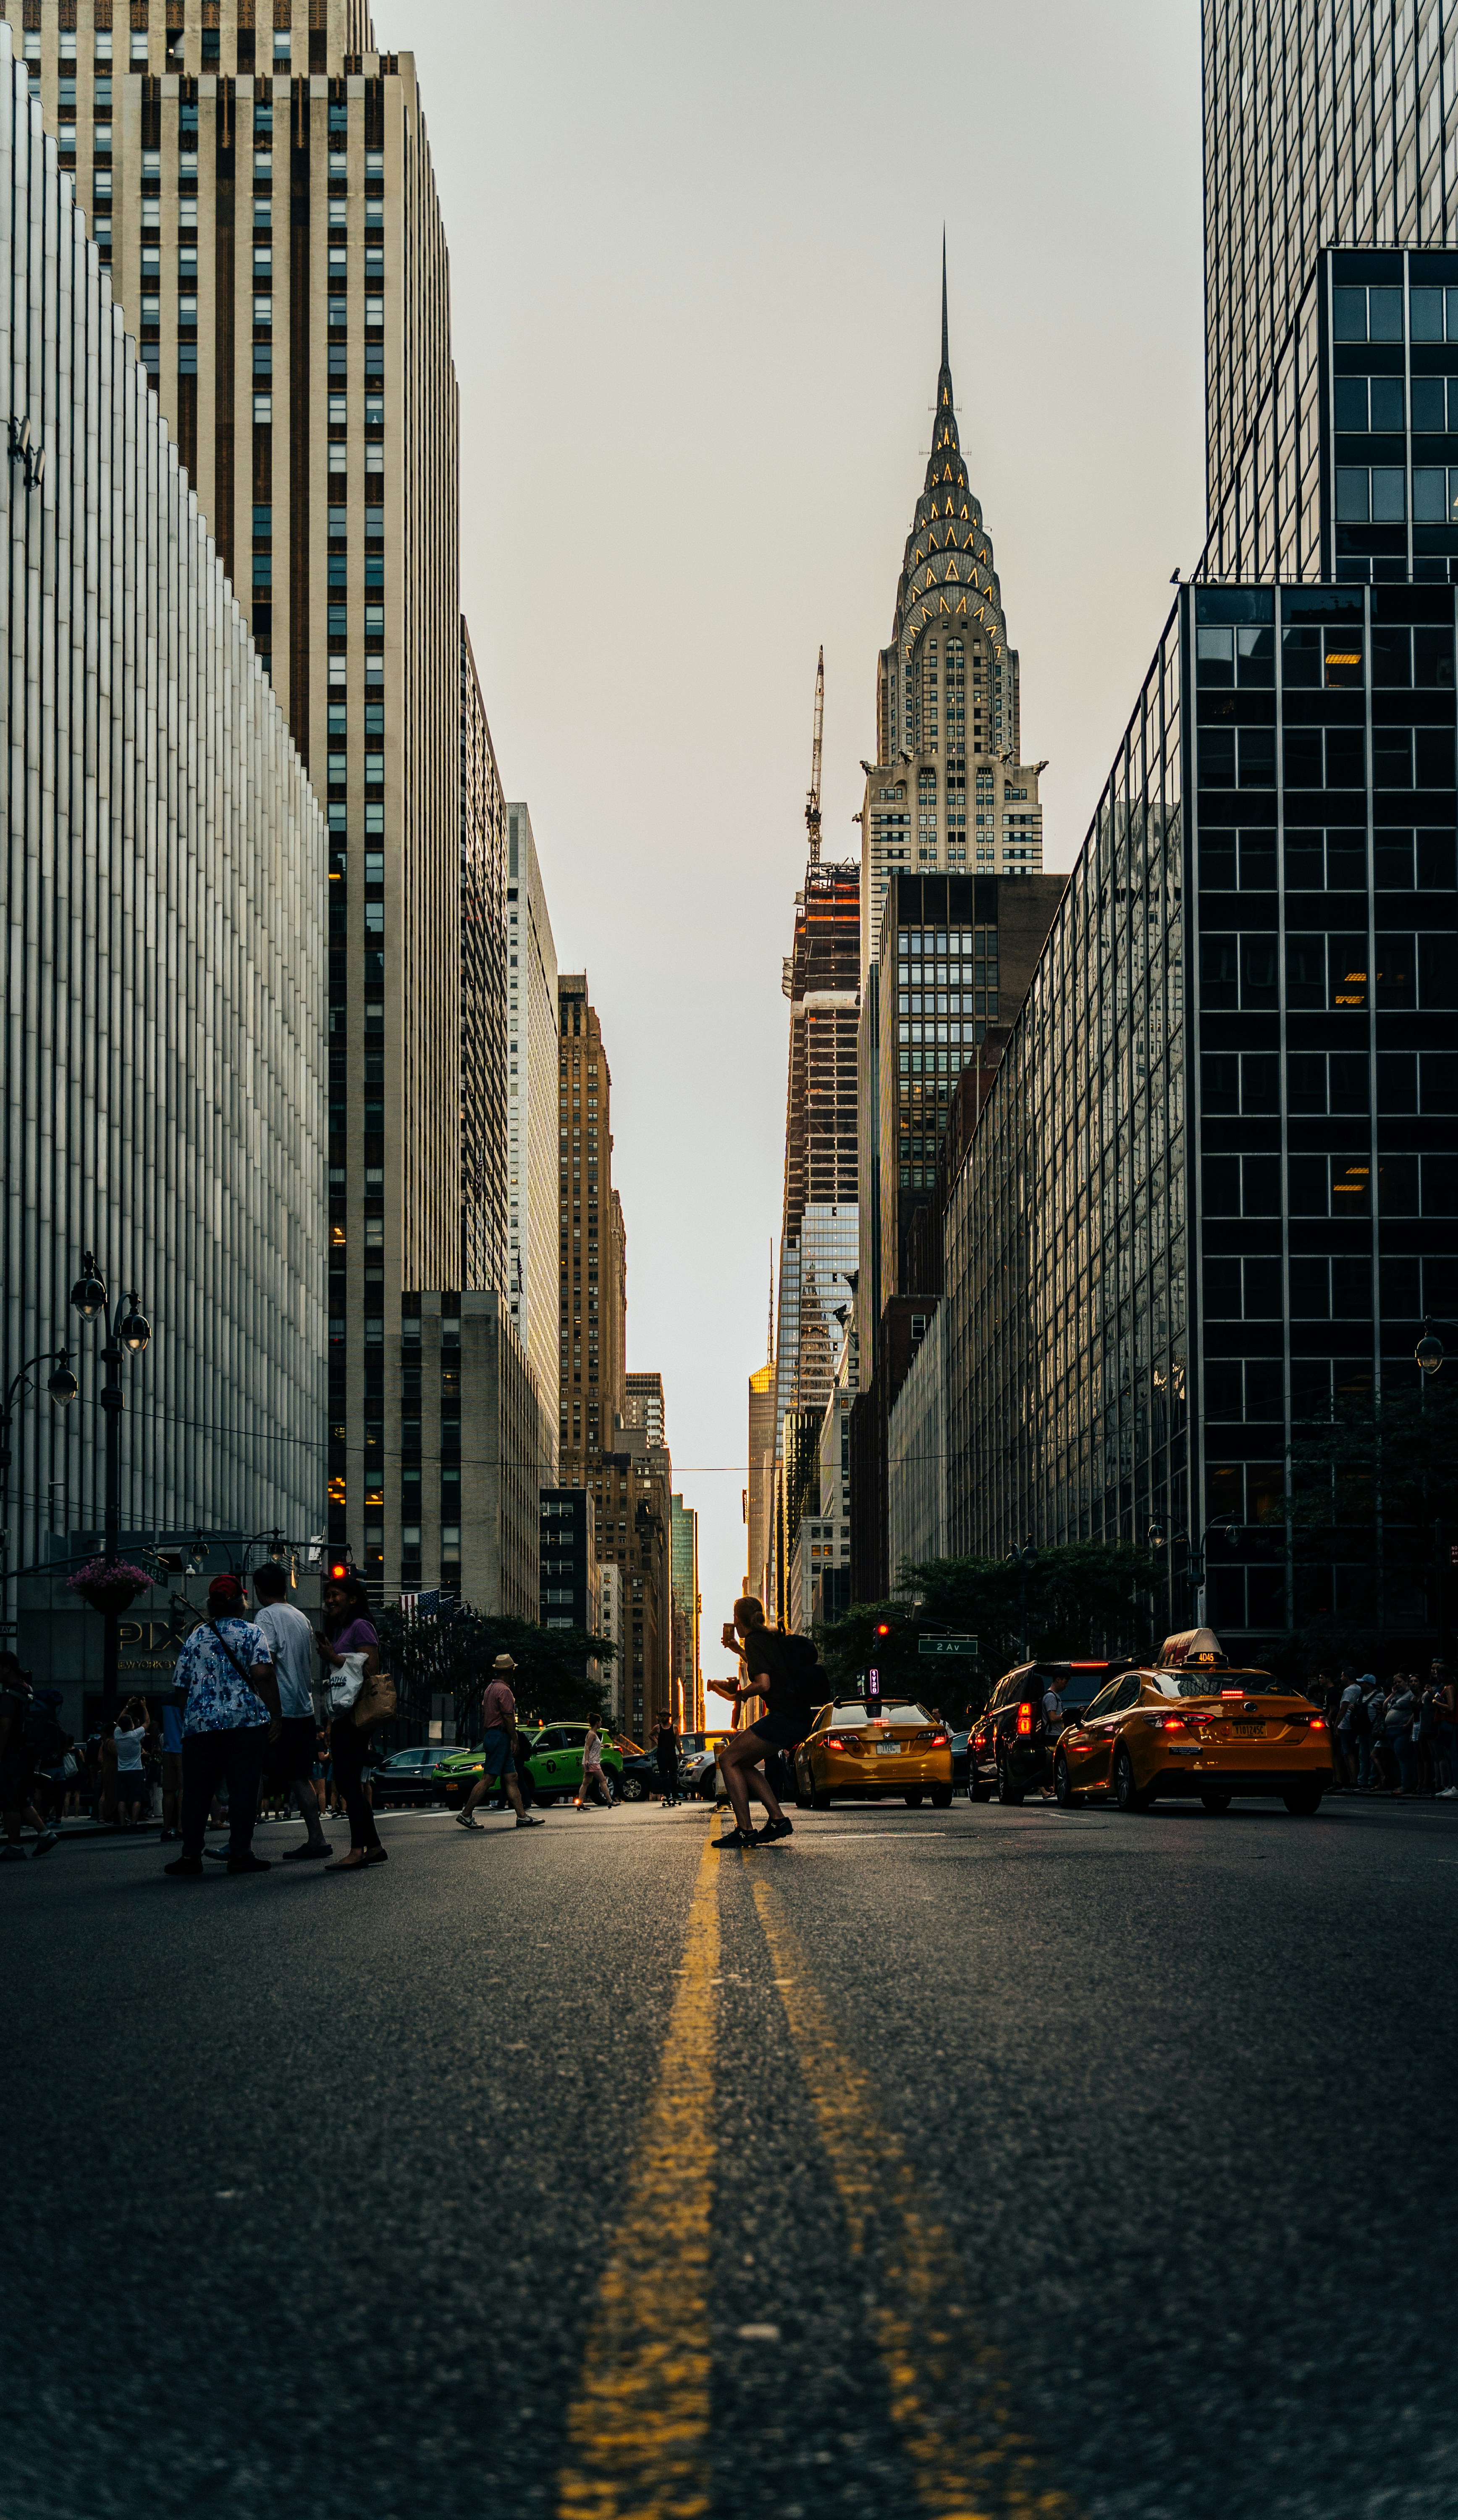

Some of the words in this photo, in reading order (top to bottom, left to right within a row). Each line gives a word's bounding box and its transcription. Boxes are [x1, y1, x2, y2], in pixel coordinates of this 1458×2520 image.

[150, 1567, 157, 1579] 42
[158, 1570, 164, 1583] St
[1199, 1653, 1214, 1662] 4D45
[1235, 1726, 1263, 1734] Y101245C
